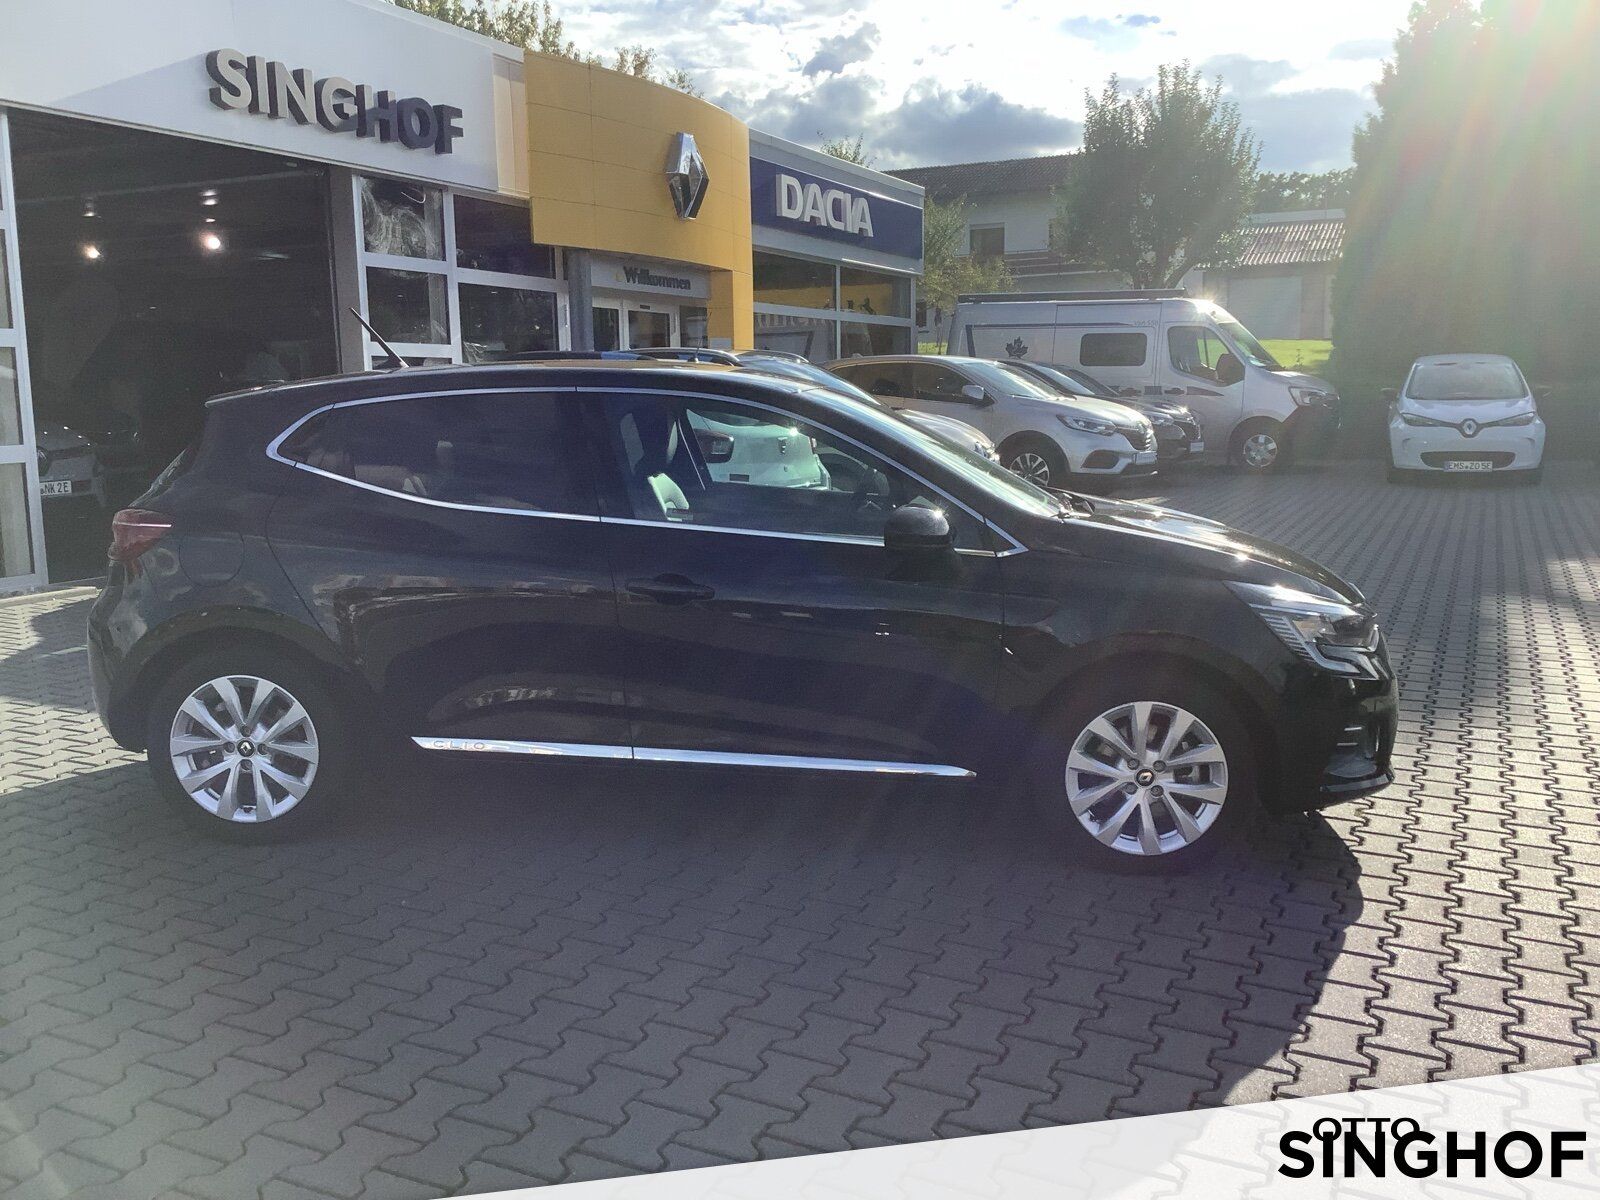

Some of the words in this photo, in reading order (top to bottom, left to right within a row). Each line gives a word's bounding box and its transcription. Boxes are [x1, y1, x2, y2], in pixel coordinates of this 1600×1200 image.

[206, 48, 464, 154] SINGHOF
[776, 173, 874, 237] DACIA
[623, 266, 691, 290] Willkommen
[1449, 462, 1465, 470] EMS
[57, 481, 69, 493] 2E
[433, 740, 485, 750] CLIO
